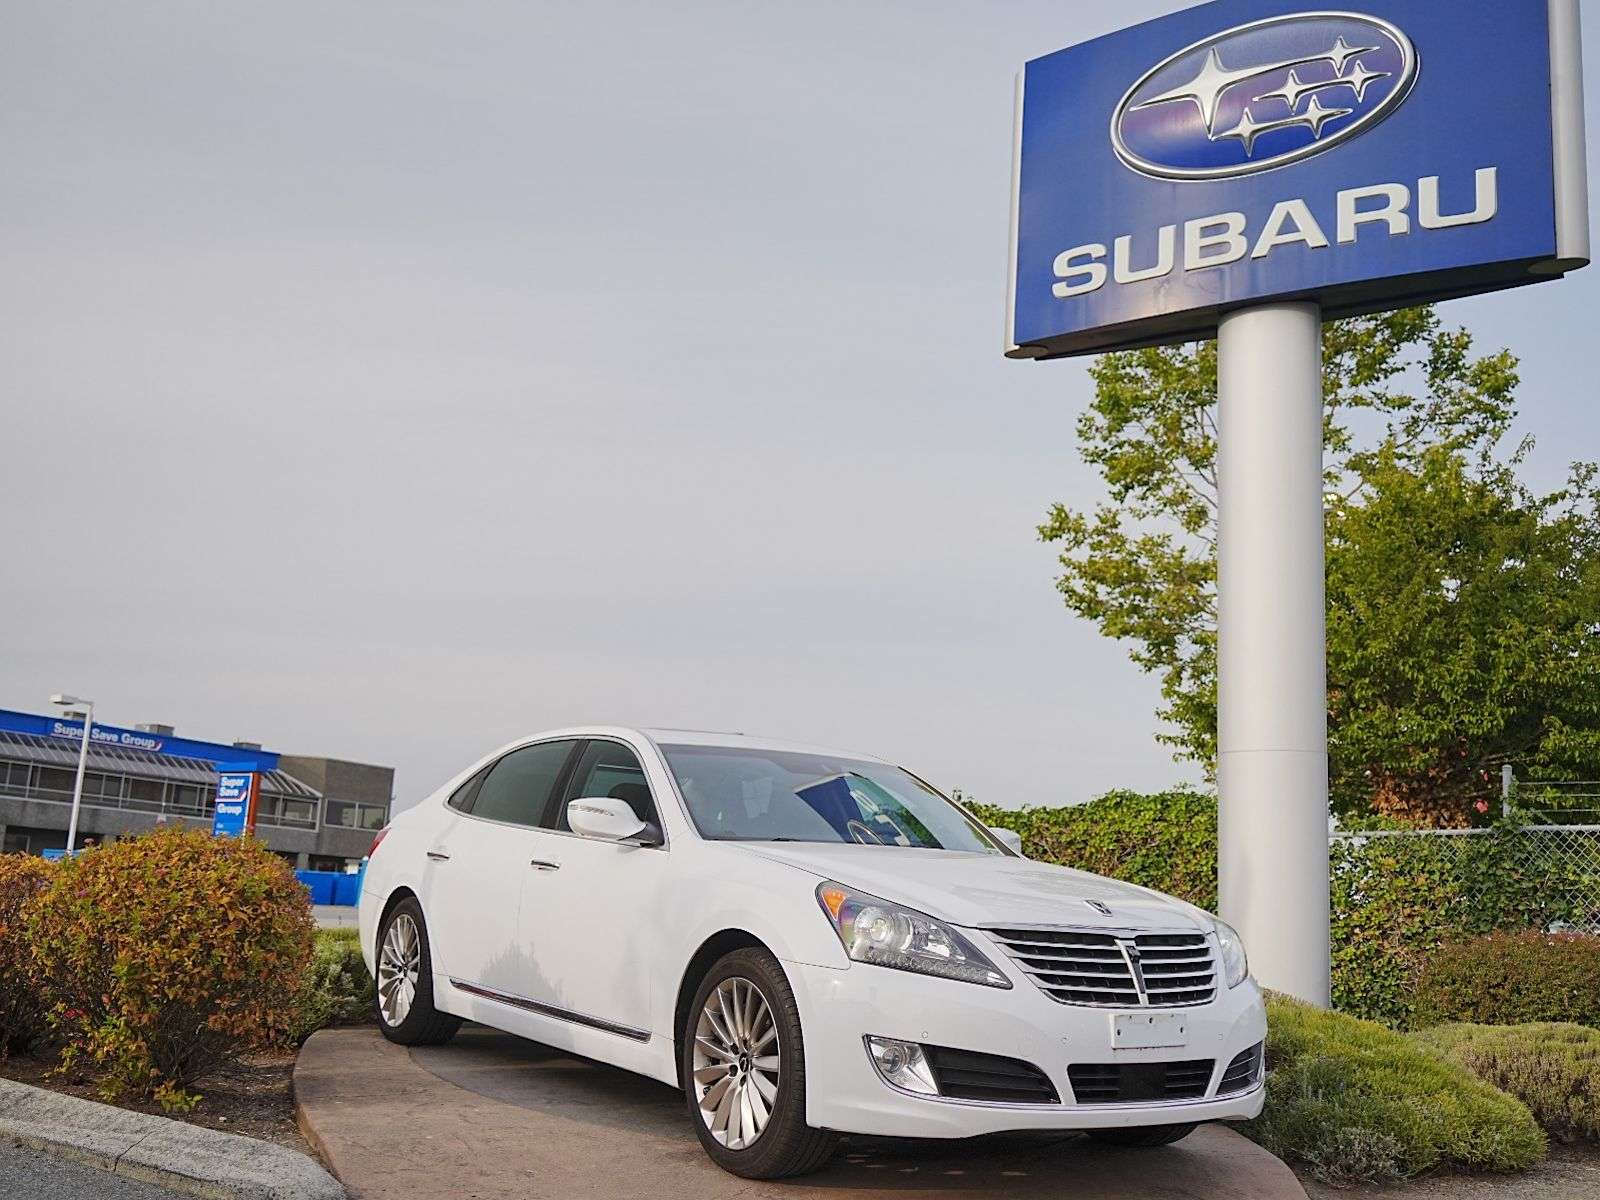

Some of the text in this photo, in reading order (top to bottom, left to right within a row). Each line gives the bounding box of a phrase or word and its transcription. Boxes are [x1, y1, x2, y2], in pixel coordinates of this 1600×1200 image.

[1051, 166, 1498, 299] SUBARU
[53, 722, 156, 749] Supe Save Group
[221, 776, 245, 788] Super
[217, 803, 243, 816] Group
